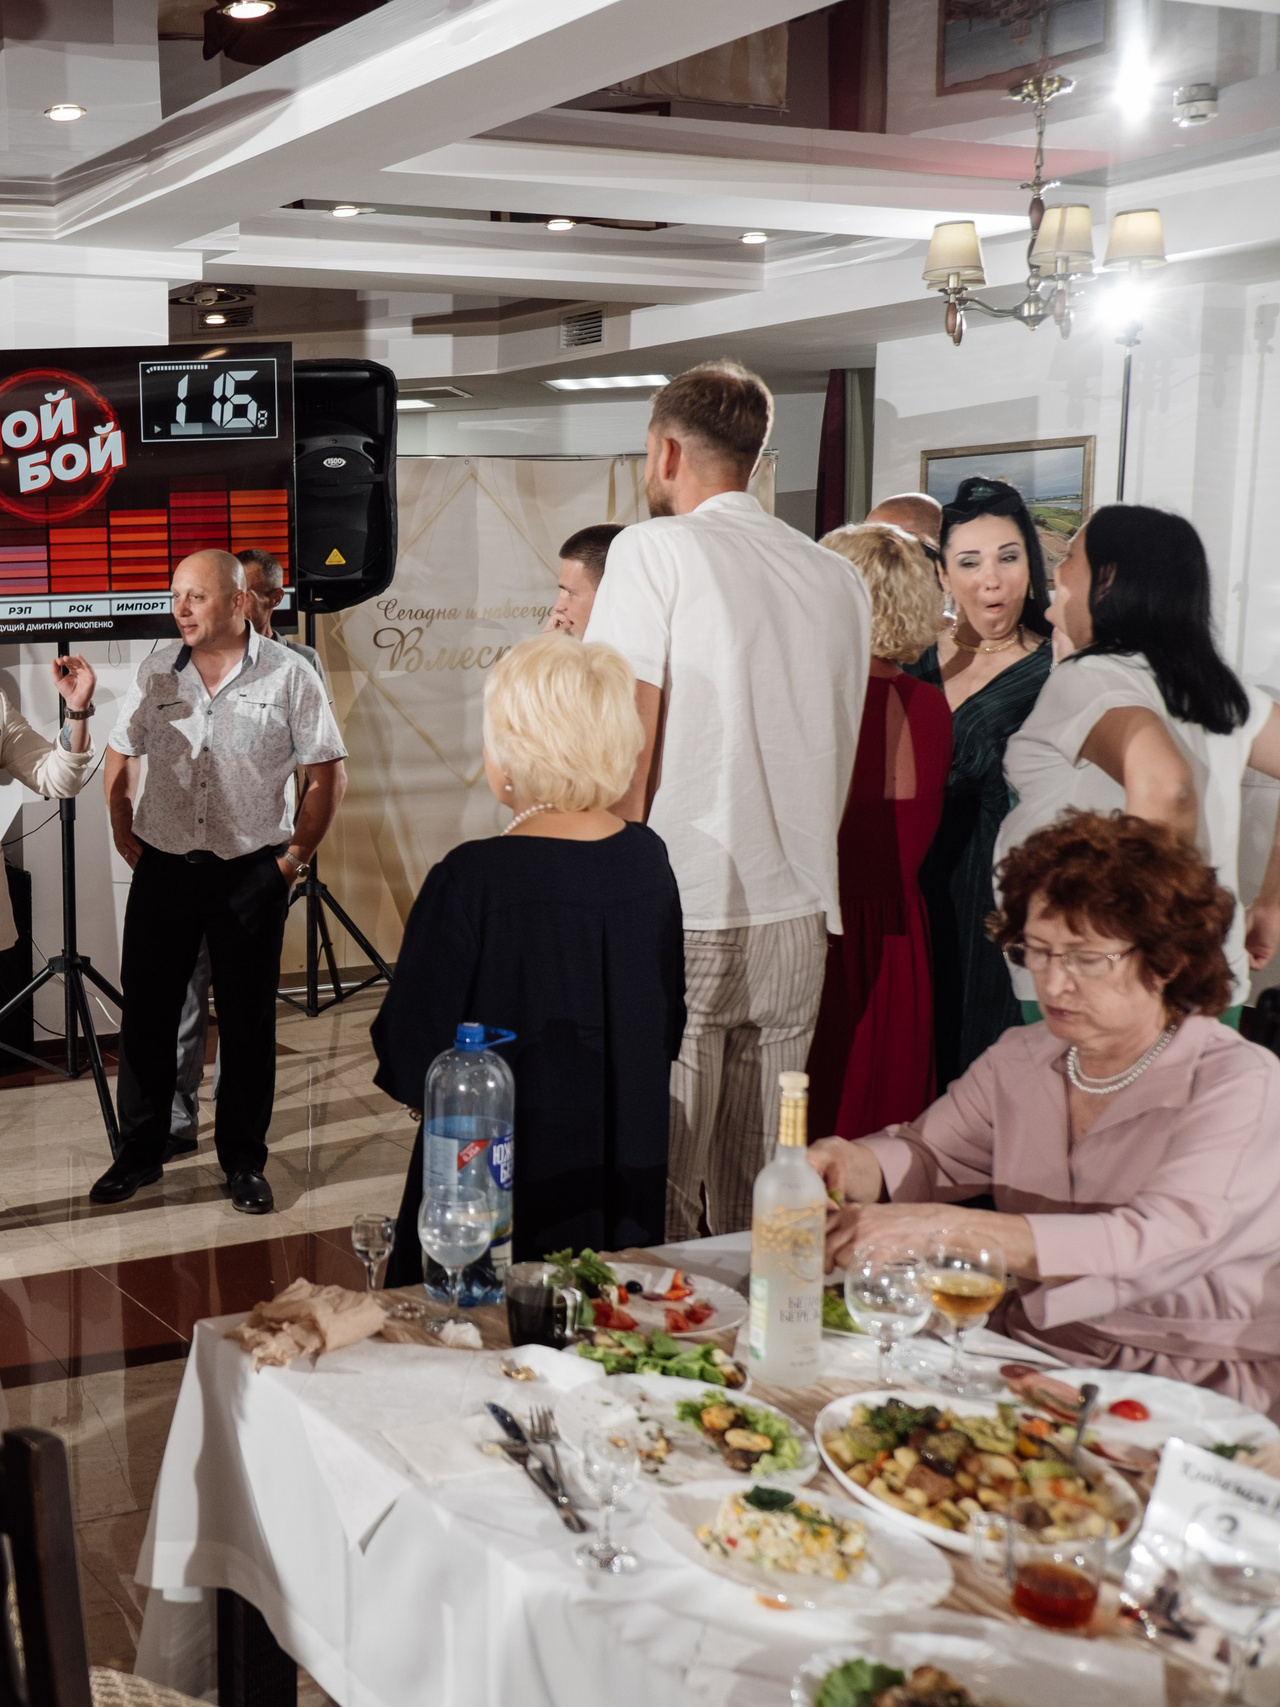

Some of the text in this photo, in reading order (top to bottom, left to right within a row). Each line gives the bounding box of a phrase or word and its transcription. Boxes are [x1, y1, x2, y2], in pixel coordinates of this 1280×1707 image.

[17, 421, 127, 494] БОЙ
[8, 606, 32, 615] РЭП
[68, 604, 93, 613] РОК
[116, 601, 166, 612] ИМПОРТ
[376, 598, 462, 627] Сегодня
[26, 621, 63, 632] ДМИТРИЙ
[64, 620, 114, 630] ПРОКОПЕНКО
